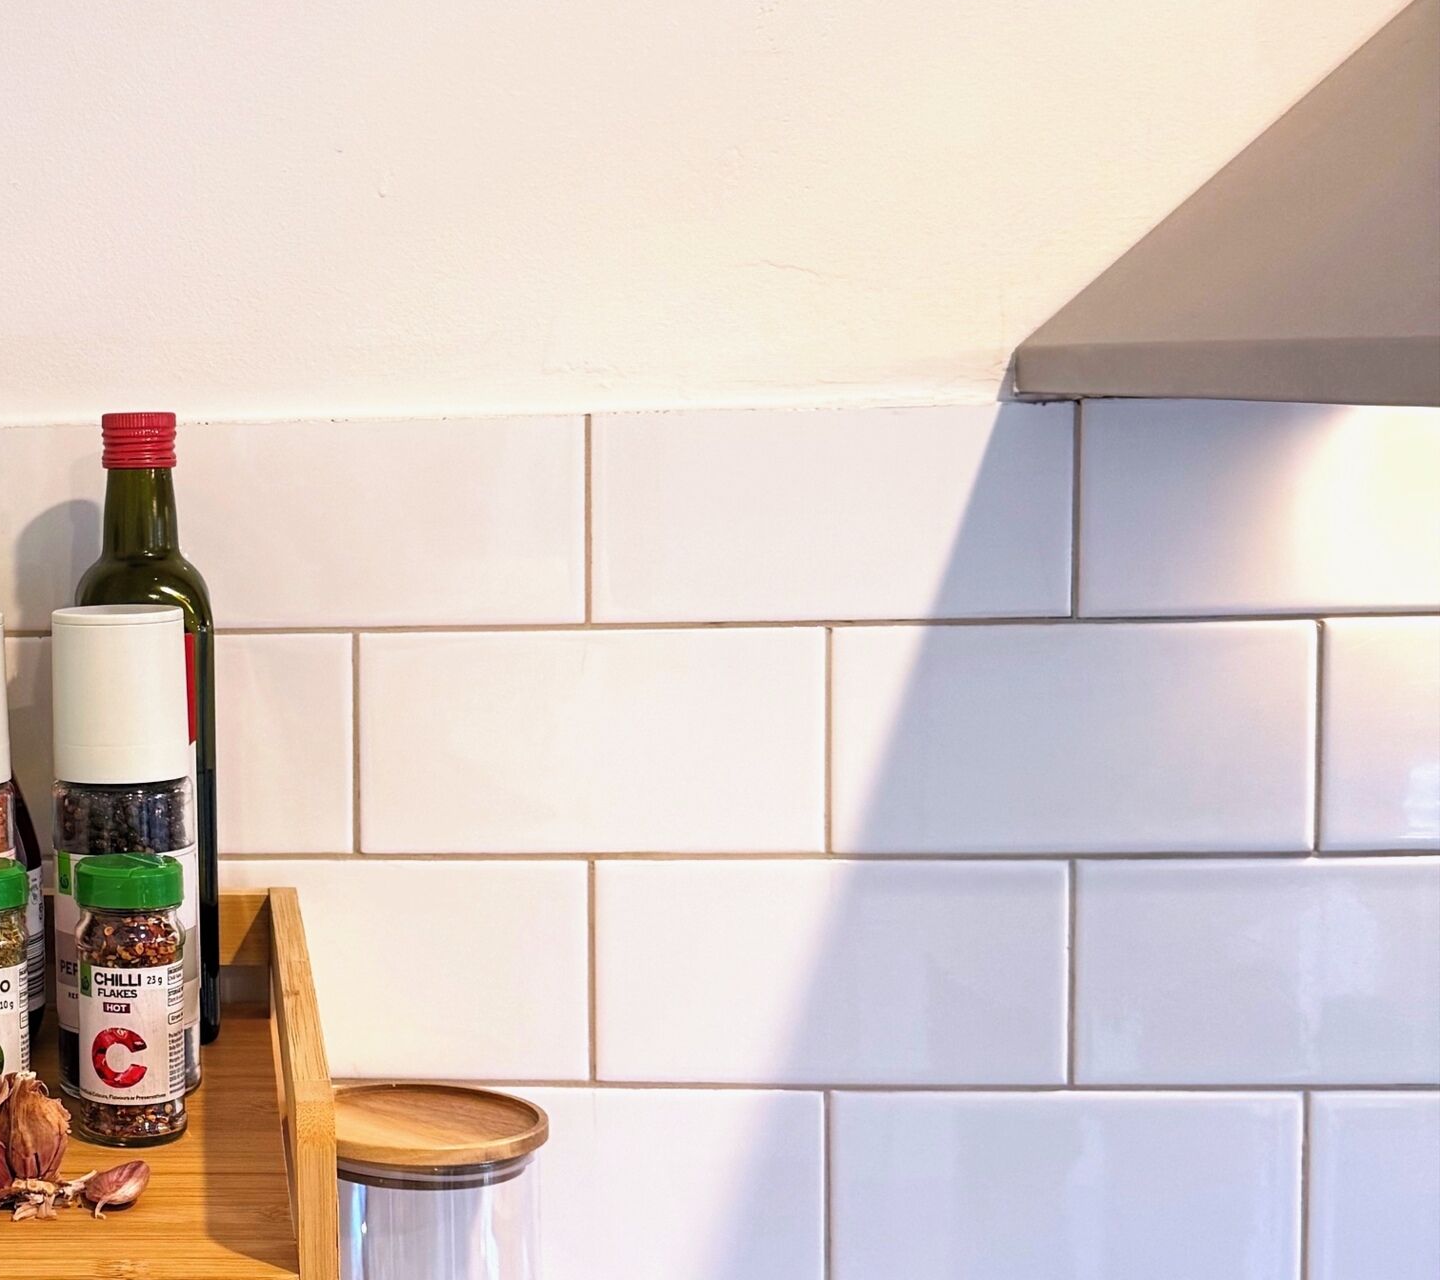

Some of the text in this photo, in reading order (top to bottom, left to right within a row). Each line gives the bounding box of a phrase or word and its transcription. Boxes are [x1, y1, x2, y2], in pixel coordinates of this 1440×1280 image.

[94, 972, 163, 987] CHILLI 23 g
[97, 988, 138, 998] FLAKES
[0, 1001, 8, 1010] 10
[106, 1003, 128, 1012] HOT
[92, 1027, 148, 1089] C
